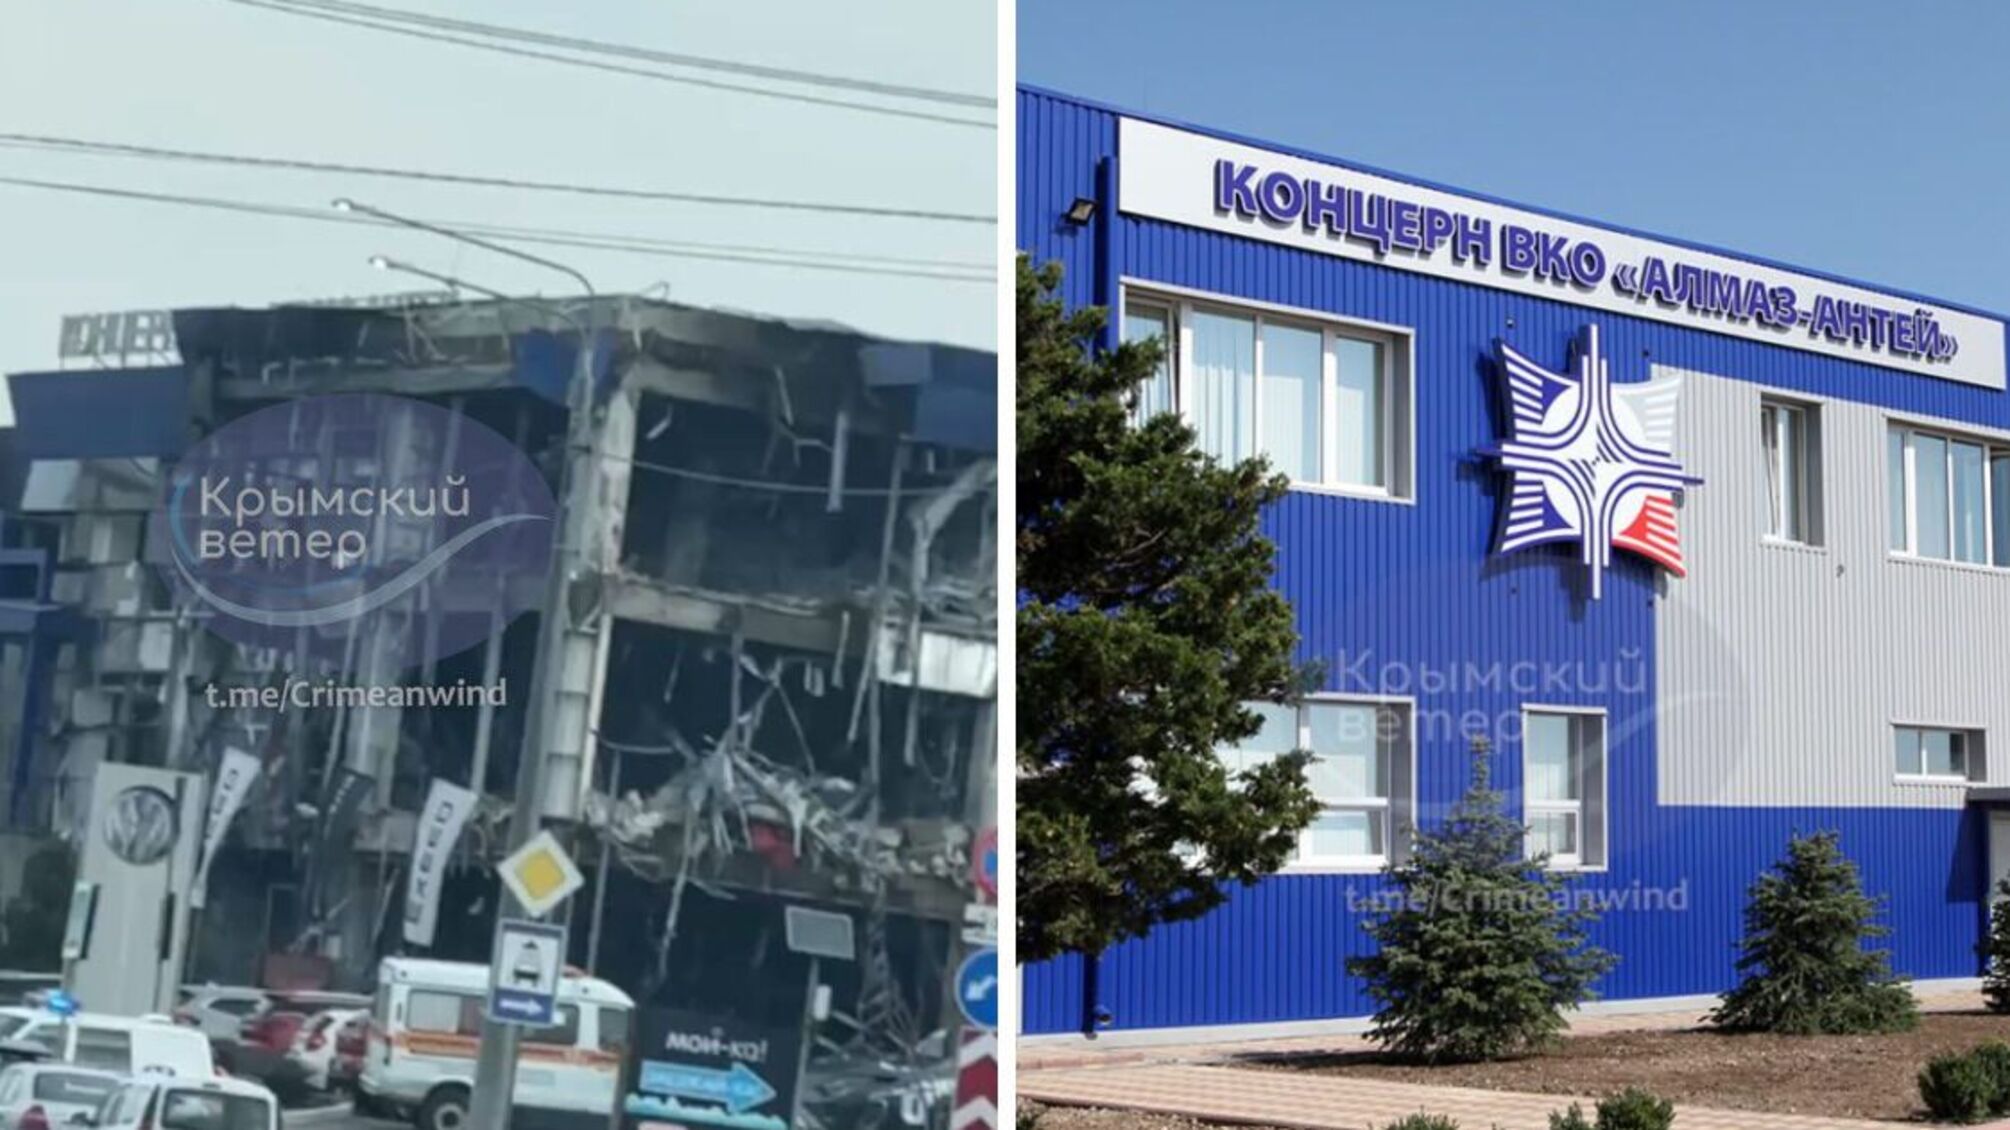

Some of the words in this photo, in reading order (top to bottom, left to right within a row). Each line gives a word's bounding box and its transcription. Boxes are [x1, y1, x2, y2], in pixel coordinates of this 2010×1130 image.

[1214, 159, 1492, 265] КОНЦЕРН
[1502, 224, 1606, 287] ВКО
[1612, 256, 1958, 360] «АЛМАЗ-АНТЕЙ»
